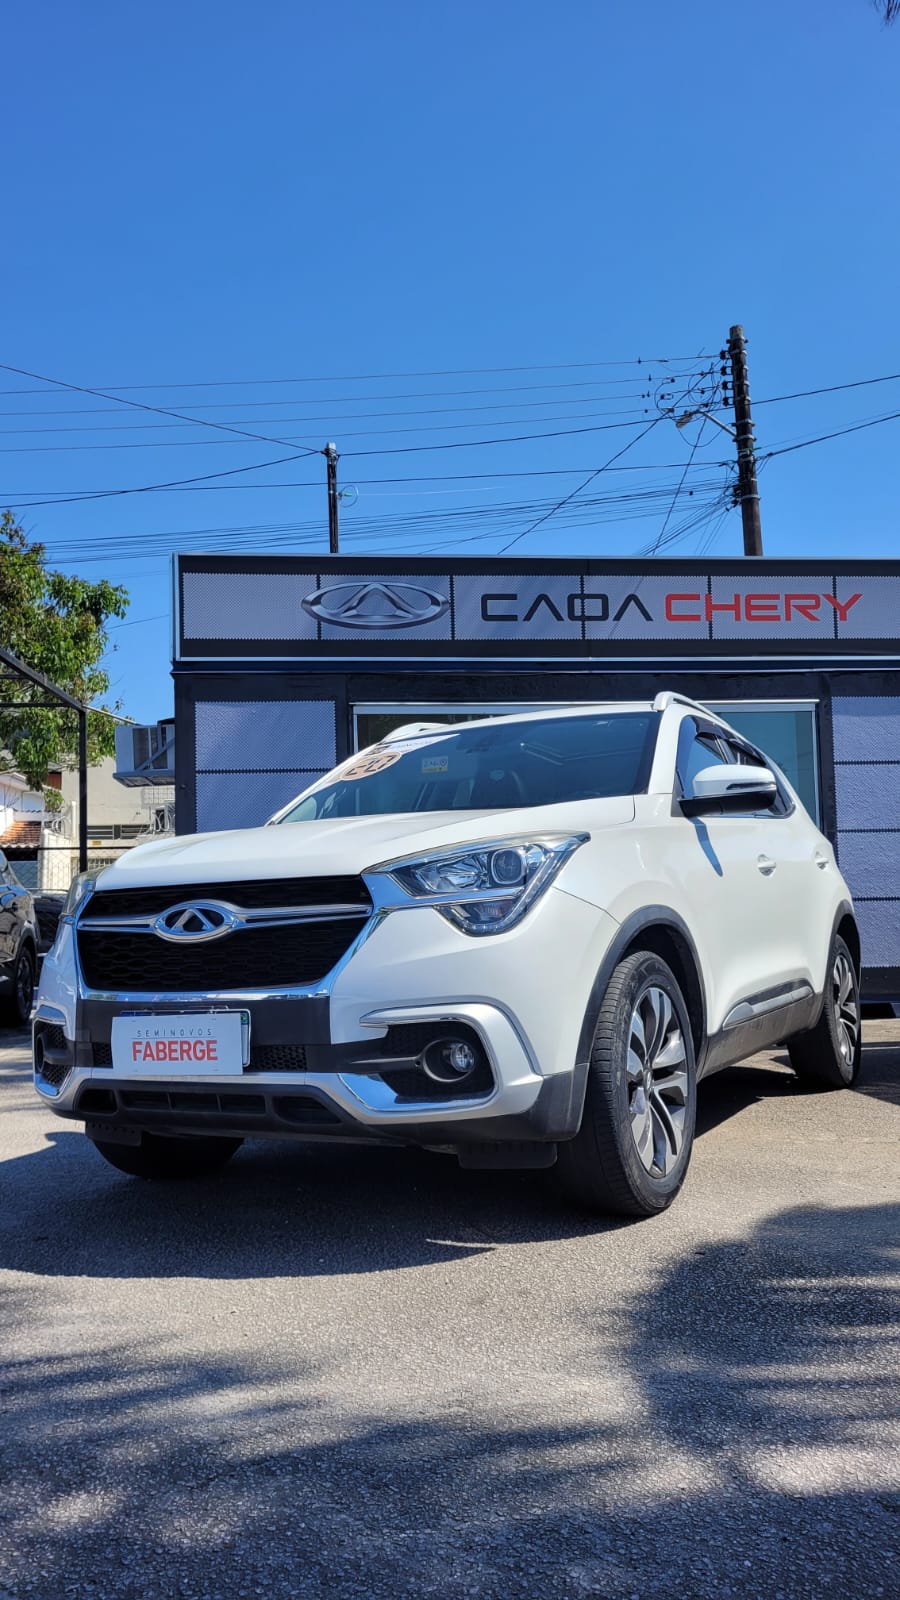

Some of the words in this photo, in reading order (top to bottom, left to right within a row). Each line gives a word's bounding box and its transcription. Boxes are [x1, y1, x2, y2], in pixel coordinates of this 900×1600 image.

[480, 593, 654, 622] CAOA
[665, 593, 863, 622] CHERY
[136, 1028, 212, 1038] SEMINOVOS
[132, 1039, 218, 1062] FABERGE
